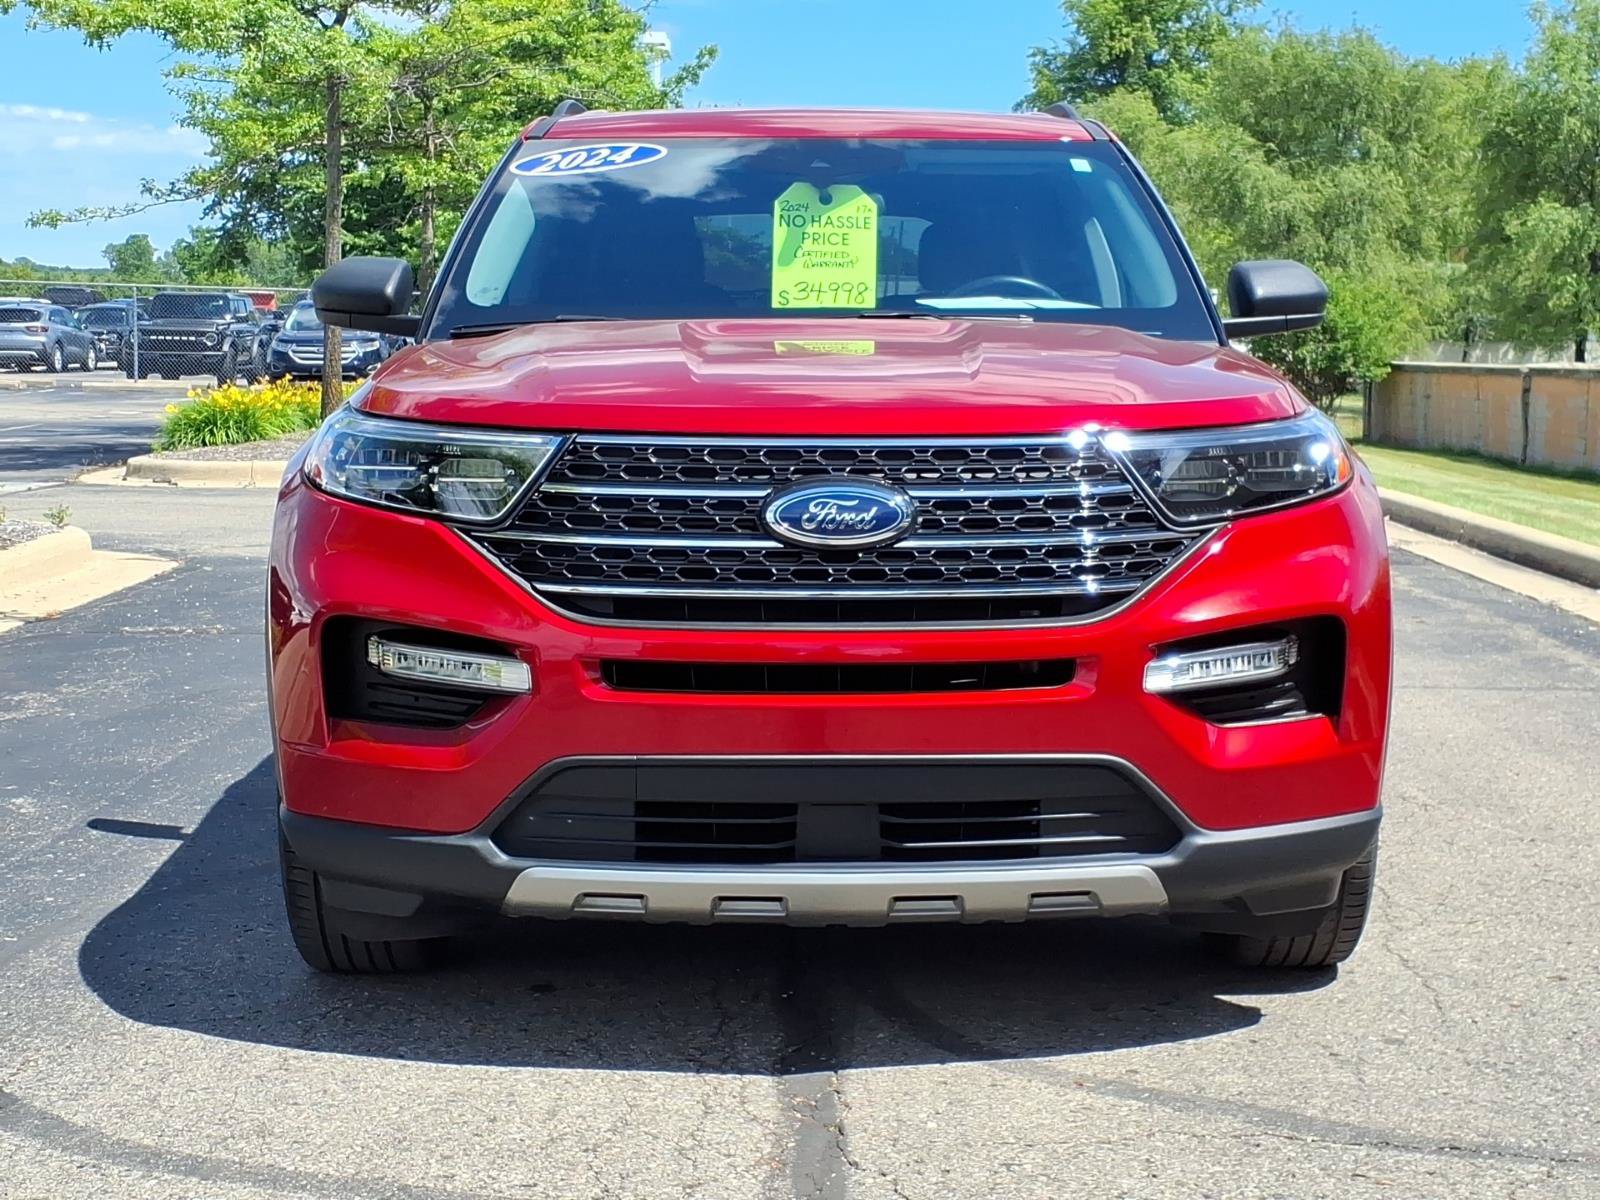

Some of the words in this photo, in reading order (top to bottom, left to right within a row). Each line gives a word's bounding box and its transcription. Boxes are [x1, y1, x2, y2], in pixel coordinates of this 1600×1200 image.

[530, 145, 639, 173] 2024
[779, 199, 810, 212] 2024
[779, 214, 806, 228] NO
[811, 215, 872, 229] HASSLE
[801, 231, 850, 246] PRICE
[793, 244, 850, 258] CERTIFIED
[801, 498, 878, 529] Ford
